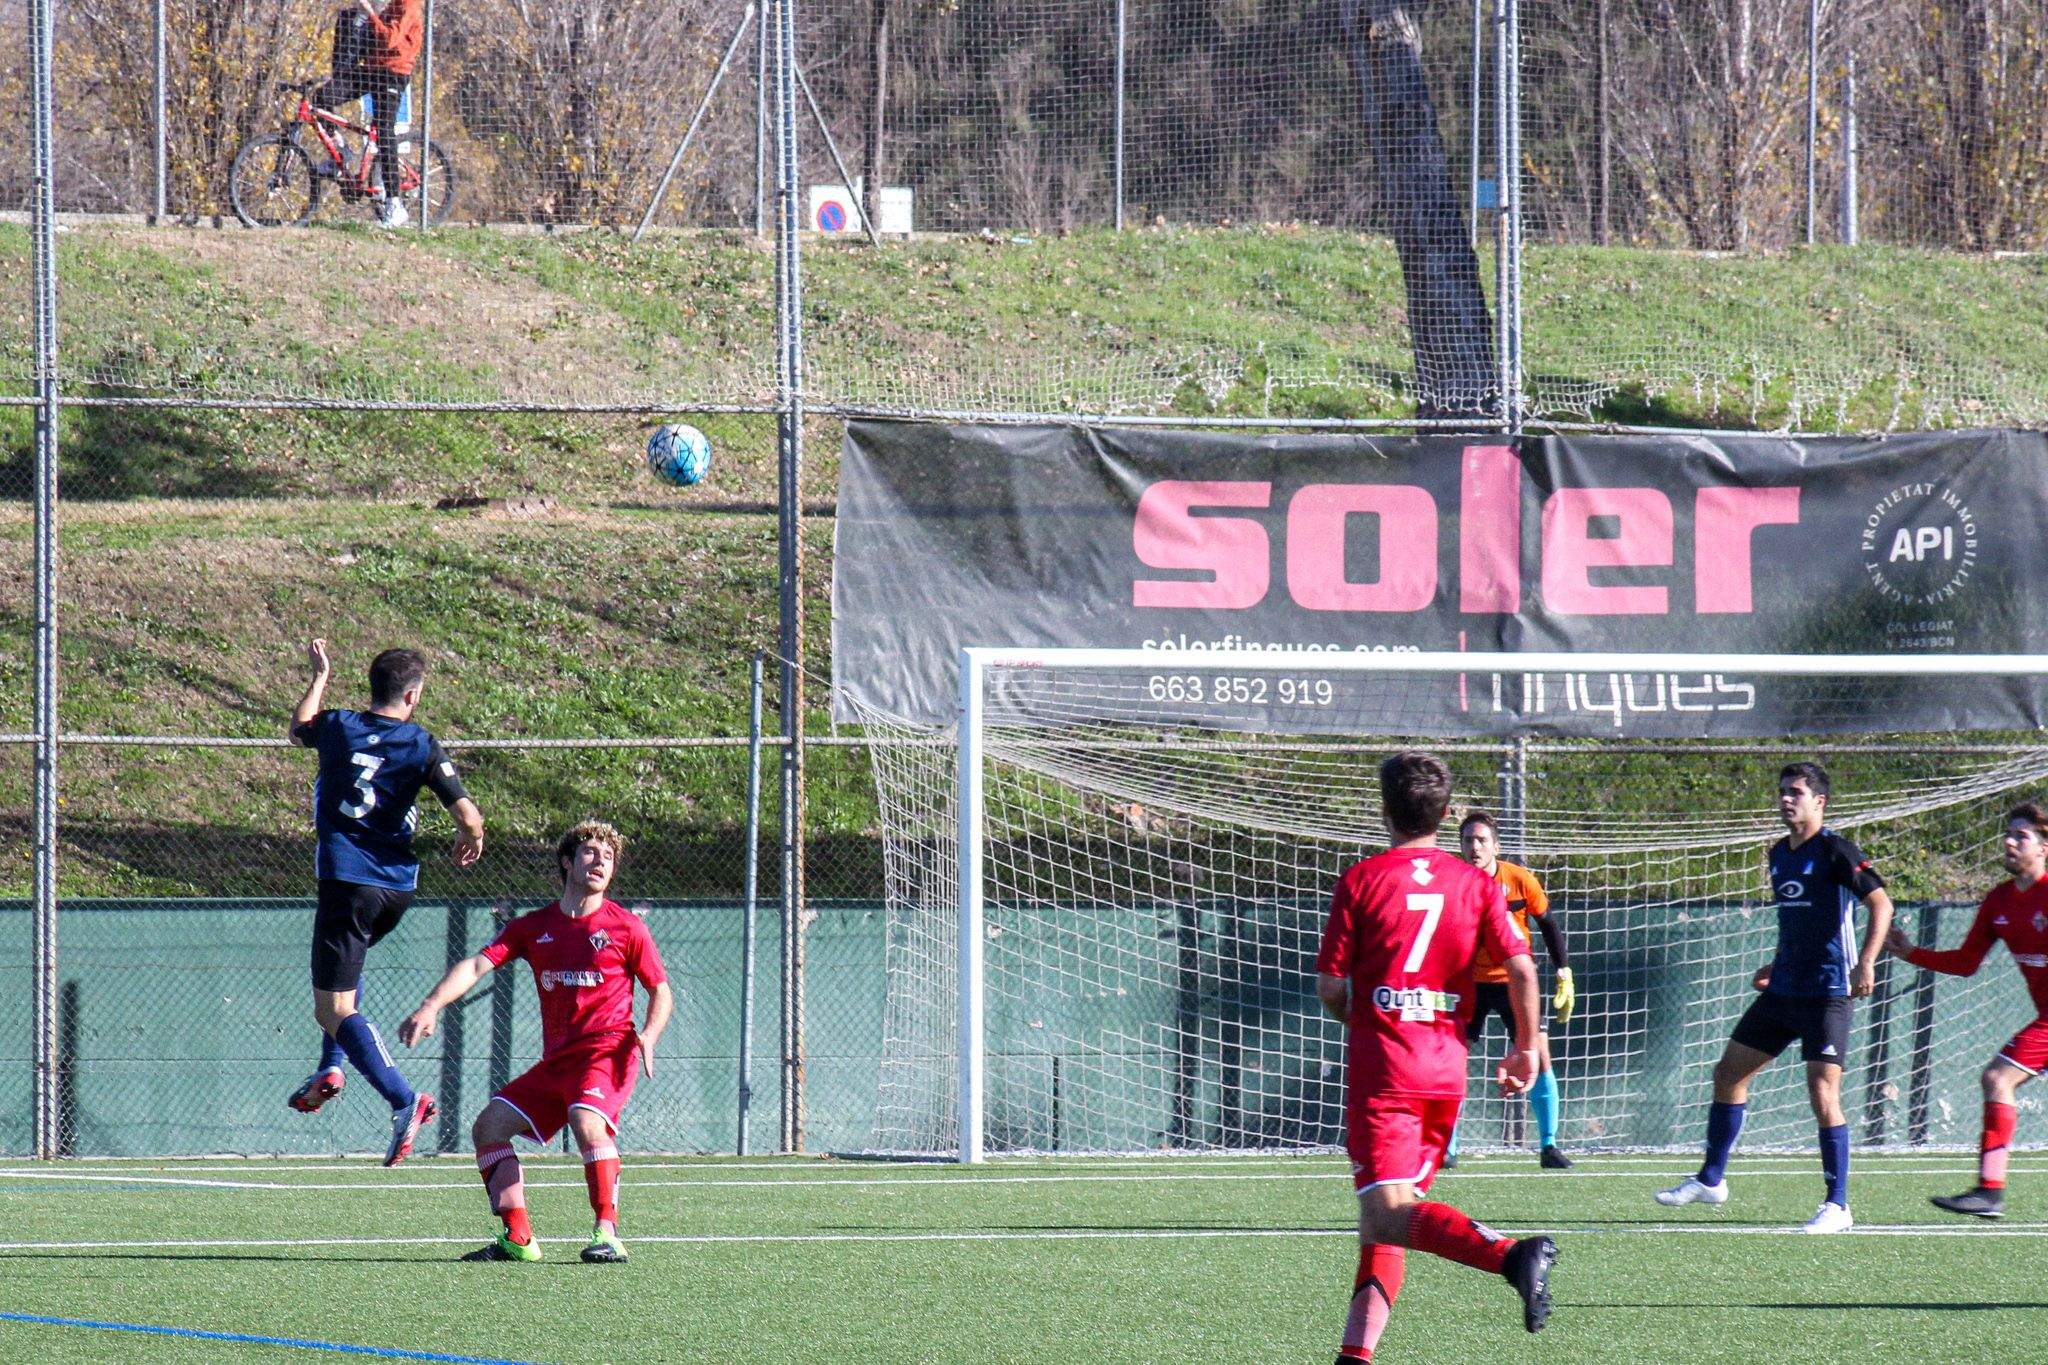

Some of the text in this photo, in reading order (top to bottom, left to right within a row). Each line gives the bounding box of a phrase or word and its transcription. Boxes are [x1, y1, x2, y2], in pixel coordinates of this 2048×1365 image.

[1133, 445, 1800, 615] soler
[1862, 483, 1935, 551] PROPIETAT
[1926, 488, 1978, 605] IMMOBILIARIA
[1889, 525, 1954, 563] API
[1149, 675, 1333, 705] 663 852 919
[338, 752, 385, 819] 3
[1403, 893, 1445, 973] 7
